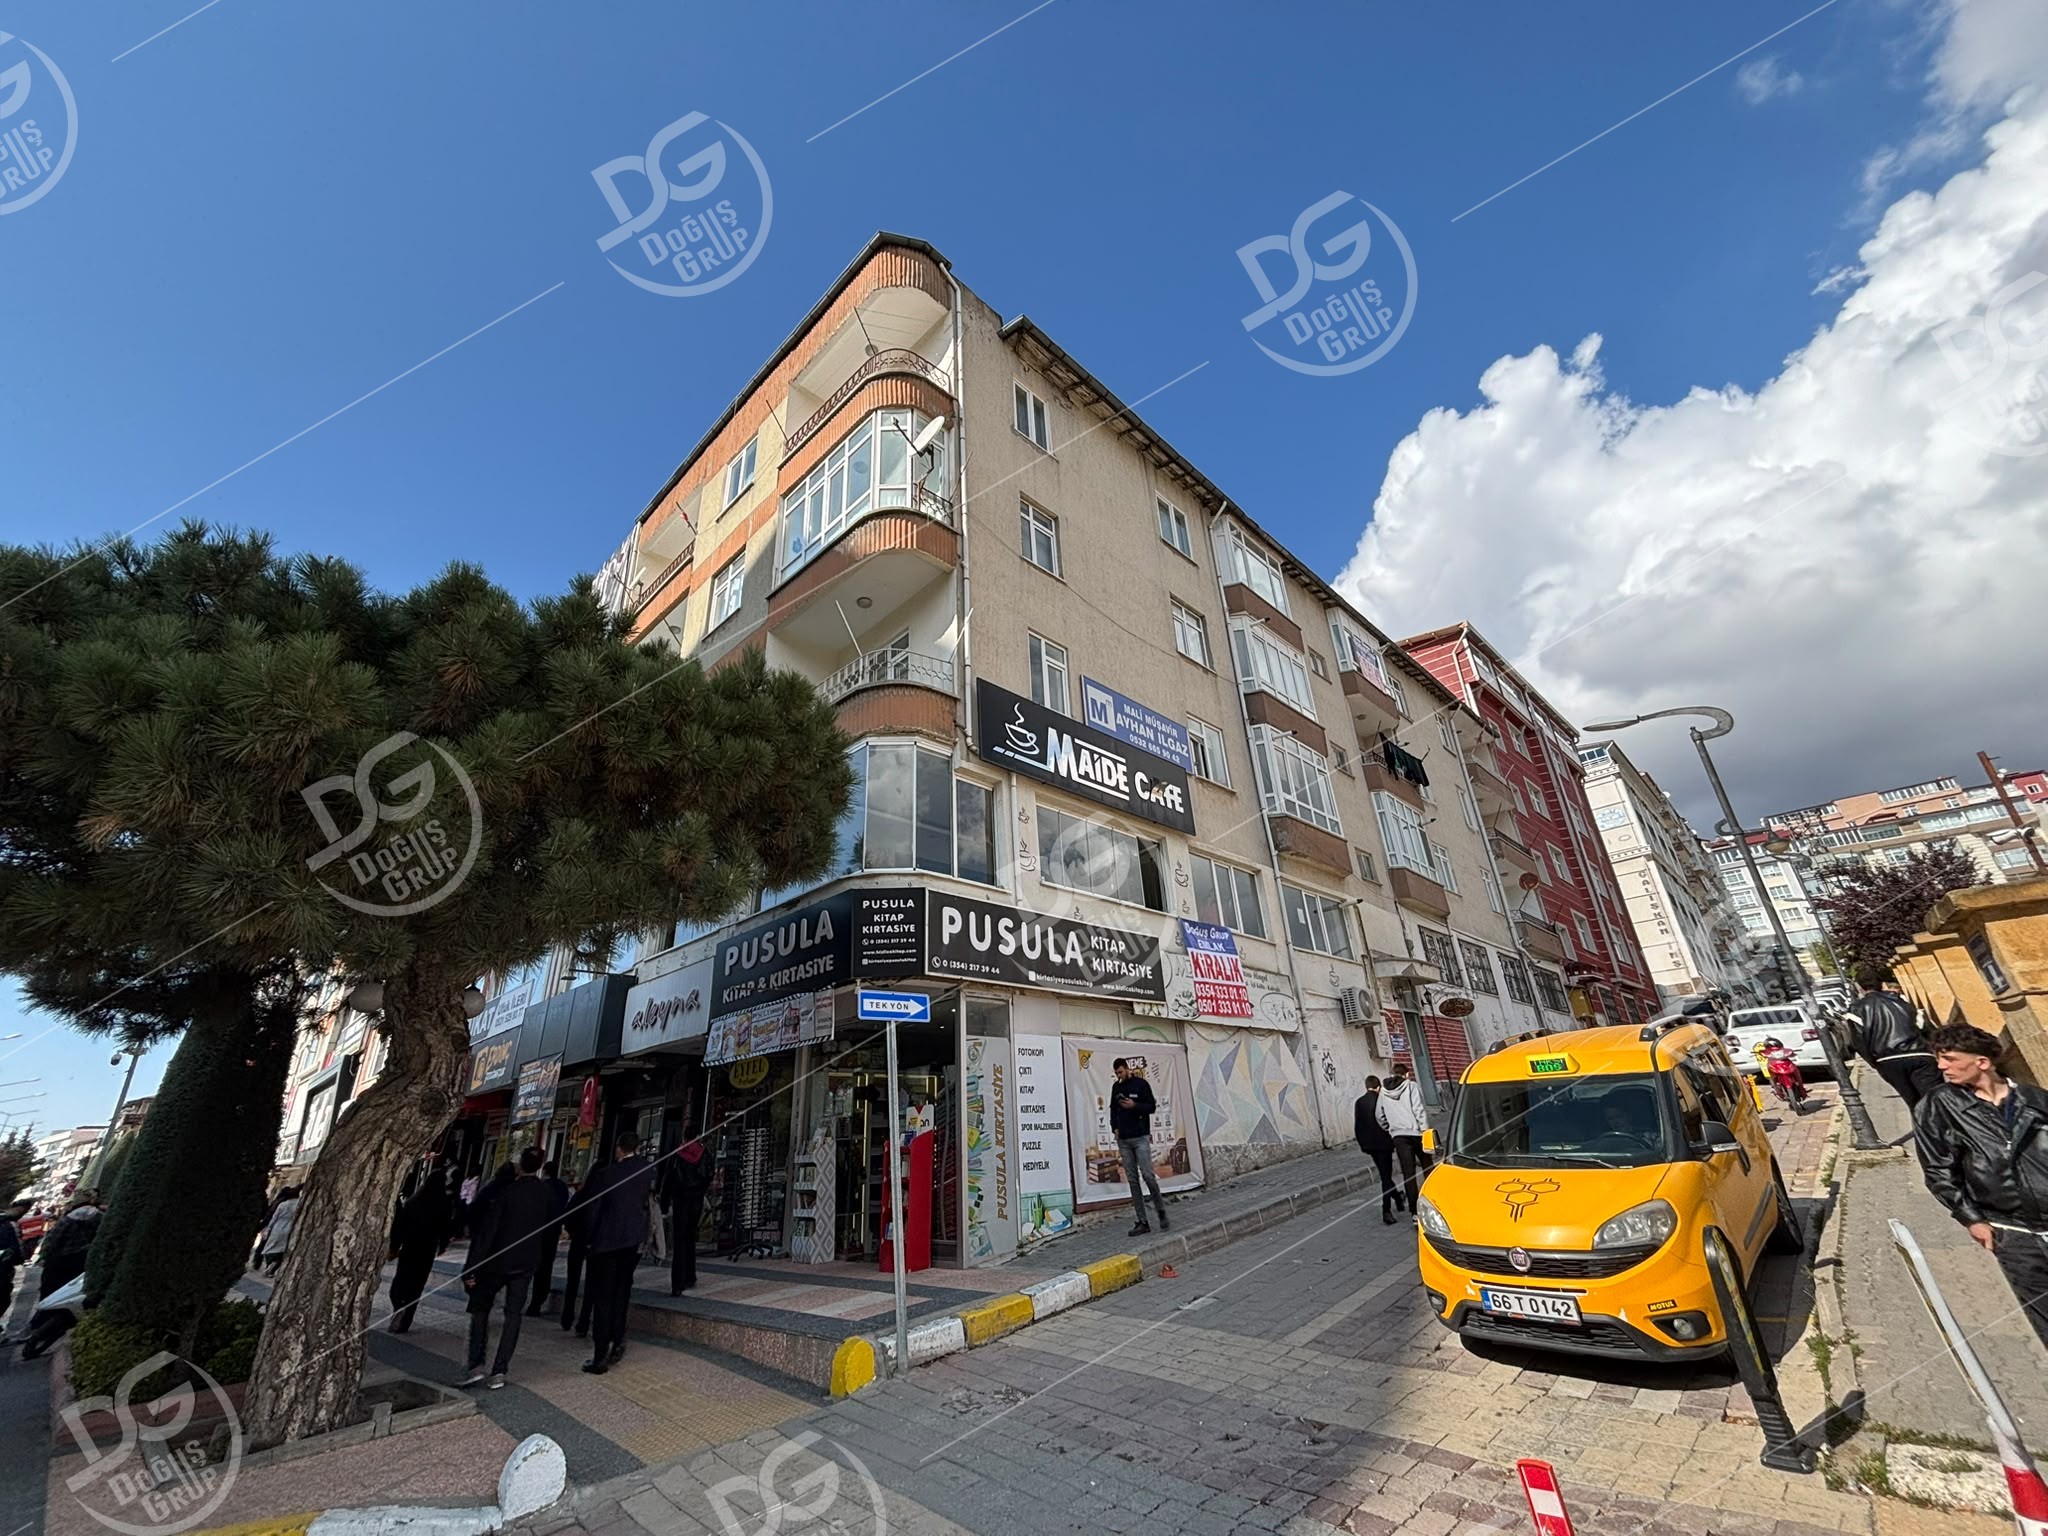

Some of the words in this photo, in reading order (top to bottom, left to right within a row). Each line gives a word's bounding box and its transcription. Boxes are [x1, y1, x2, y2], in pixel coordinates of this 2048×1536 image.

[1116, 713, 1154, 741] AYHAN
[863, 899, 915, 909] PUSULA
[874, 913, 904, 922] KİTAP
[863, 924, 915, 934] KIRTASİYE
[942, 906, 1083, 966] PUSULA
[724, 910, 834, 977] PUSULA
[1091, 935, 1126, 954] KİTAP
[769, 954, 834, 989] KIRTASİYE
[943, 960, 948, 968] 0
[949, 961, 968, 971] (354)
[969, 963, 980, 972] 217
[981, 965, 990, 973] 39
[991, 967, 1000, 975] 44
[1092, 957, 1152, 979] KIRTASİYE
[1191, 951, 1244, 982] KİRALIK
[1196, 983, 1215, 998] 0354
[1215, 986, 1228, 999] 333
[1240, 988, 1248, 1001] 10
[632, 988, 700, 1032] aleyna
[869, 1001, 887, 1009] TEK
[890, 1002, 909, 1010] YÖN
[1219, 1001, 1232, 1014] 333
[1242, 1002, 1251, 1014] 10
[1018, 1047, 1044, 1057] FOTOKOPİ
[1019, 1066, 1032, 1077] ÇIKTI
[1020, 1083, 1034, 1094] KİTAP
[991, 1064, 1006, 1149] KIRTASİYE
[1020, 1103, 1045, 1114] KIRTASİYE
[1021, 1123, 1032, 1131] SPOR
[1022, 1141, 1041, 1151] PUZZLE
[1022, 1158, 1050, 1171] HEDİYELİK
[993, 1152, 1008, 1221] PUSULA
[1491, 1293, 1512, 1310] 66
[1514, 1296, 1524, 1311] T
[1529, 1297, 1573, 1318] 0142
[1649, 1301, 1675, 1311] MOTUL
